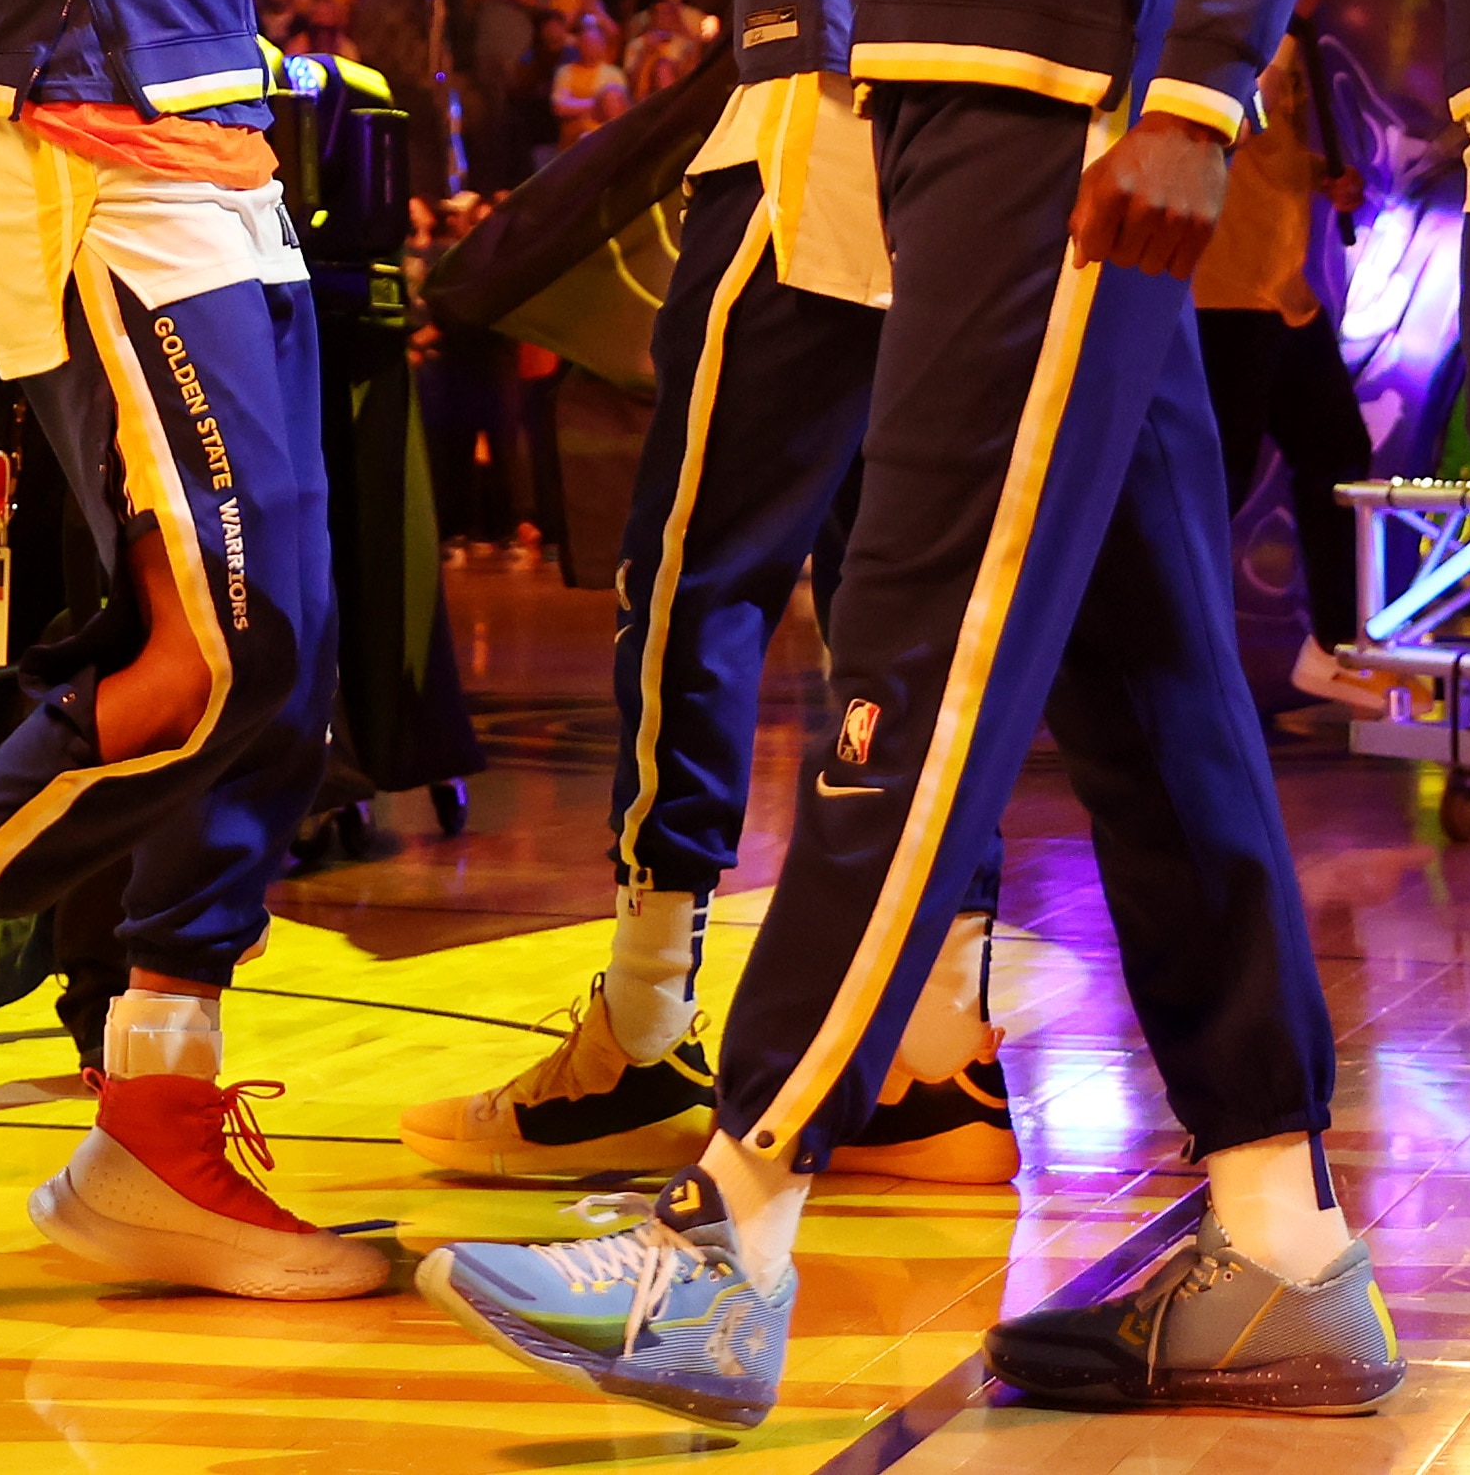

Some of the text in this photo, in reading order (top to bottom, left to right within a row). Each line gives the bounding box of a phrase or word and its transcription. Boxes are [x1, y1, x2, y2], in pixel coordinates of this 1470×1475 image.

[153, 316, 250, 632] GOLDEN STATE WARRIORS
